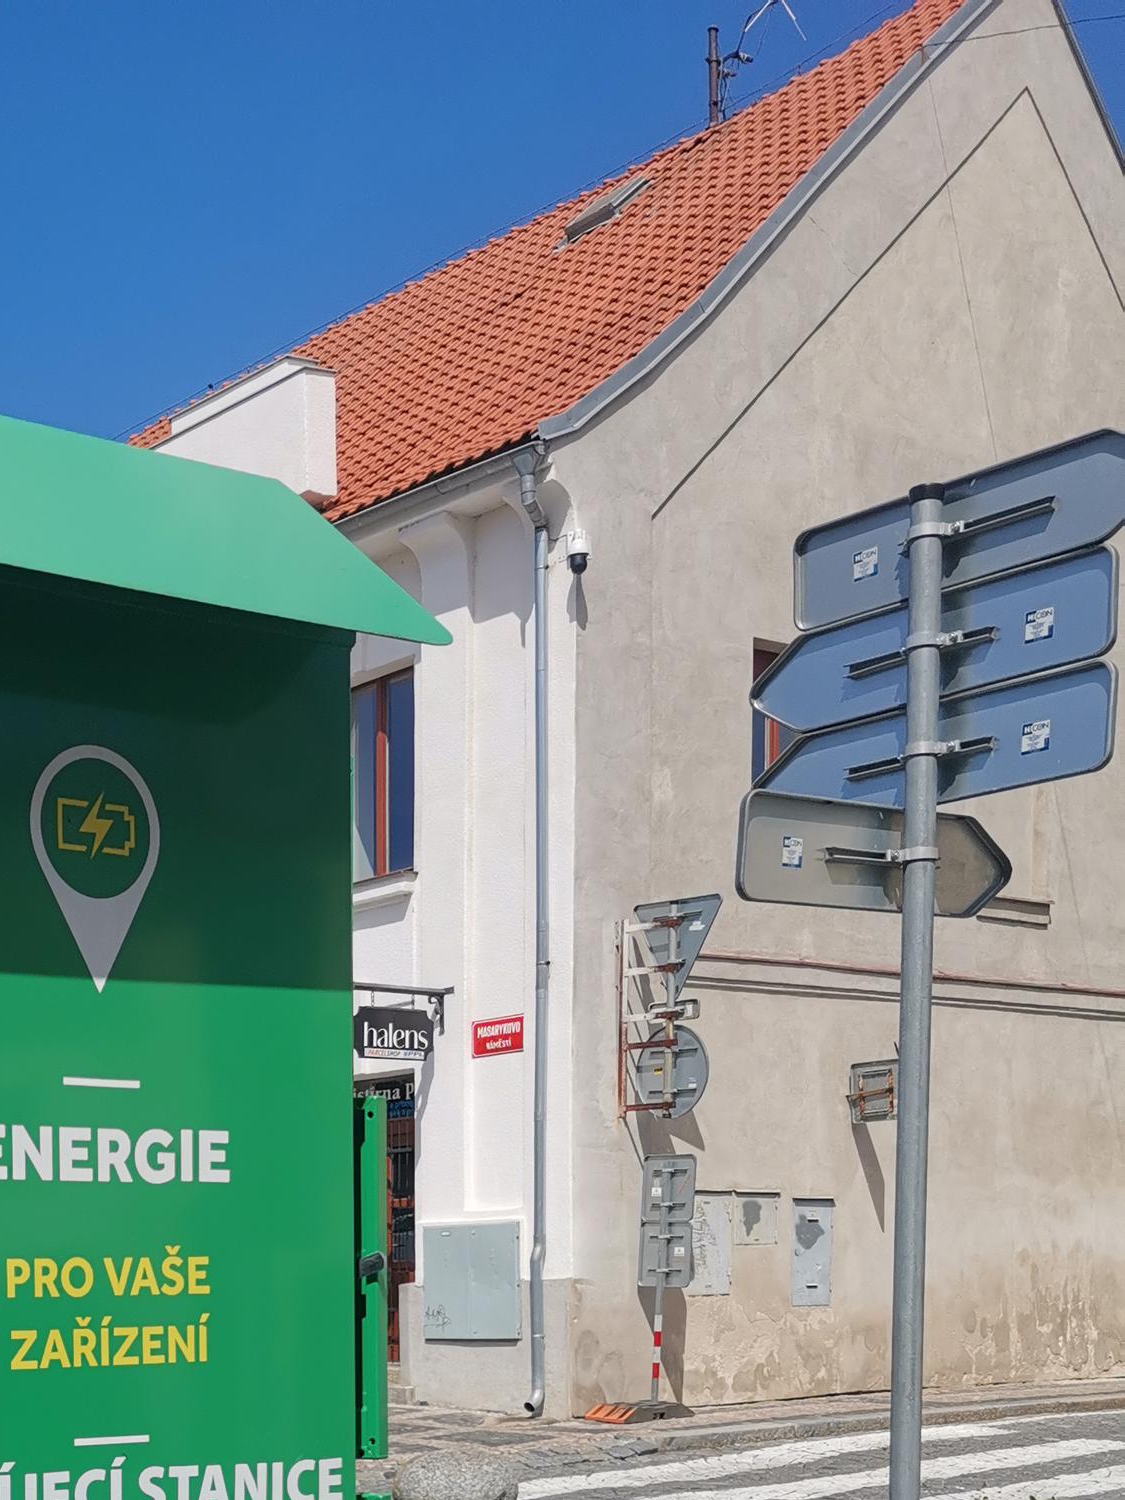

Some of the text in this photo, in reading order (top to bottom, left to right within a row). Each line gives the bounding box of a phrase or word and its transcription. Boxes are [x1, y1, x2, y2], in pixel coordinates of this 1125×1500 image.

[363, 1021, 428, 1050] halens
[477, 1021, 521, 1039] MASARYKOVO
[6, 1246, 211, 1298] PRO VAŠE
[10, 1313, 211, 1370] ZAŘÍZENÍ
